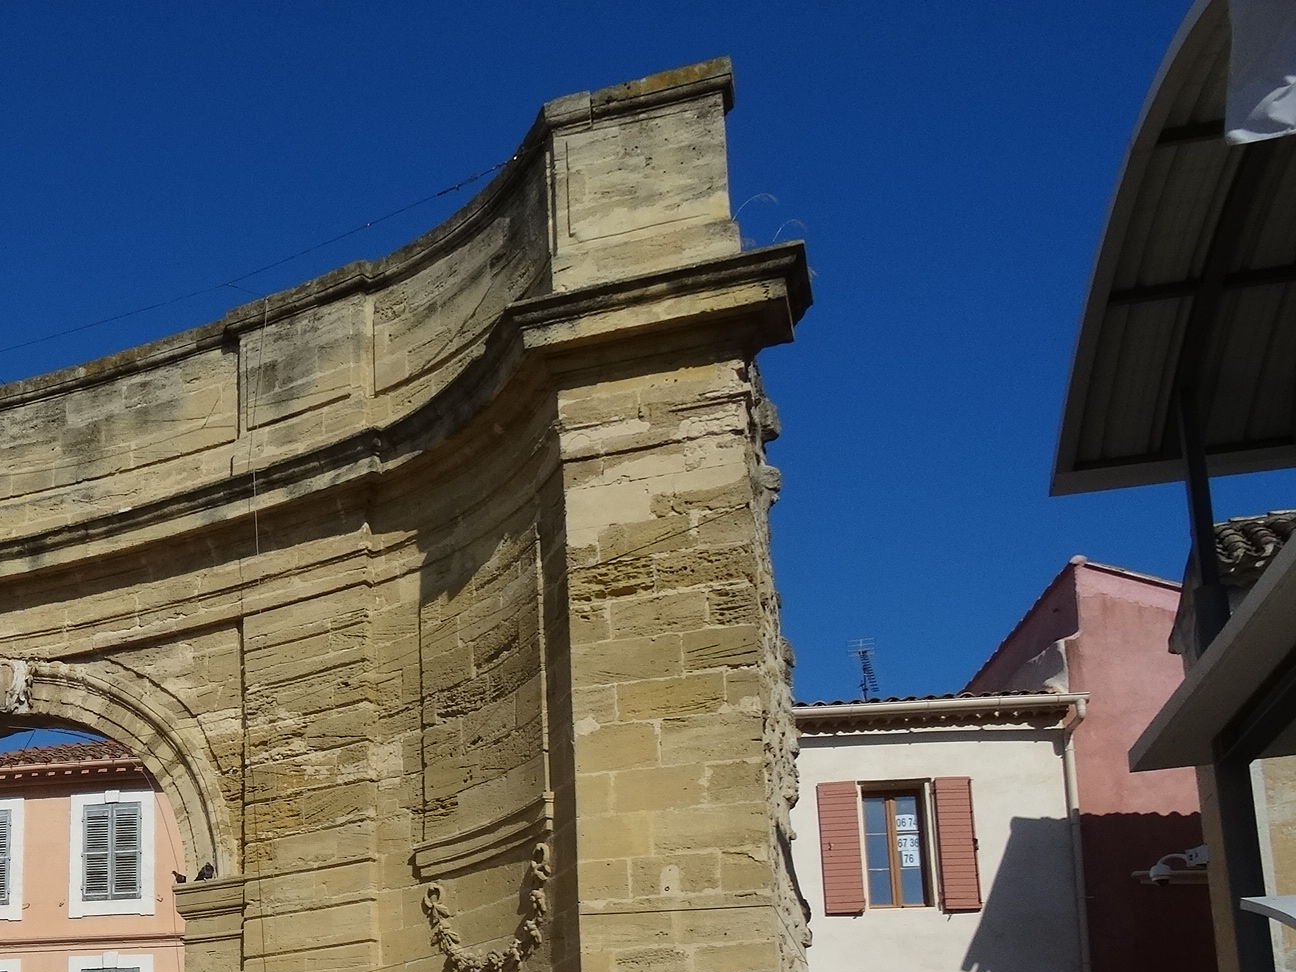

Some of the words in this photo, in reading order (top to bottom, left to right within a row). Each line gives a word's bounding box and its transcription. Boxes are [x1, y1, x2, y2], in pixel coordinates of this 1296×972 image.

[896, 818, 907, 828] 06
[897, 838, 908, 848] 67
[903, 853, 914, 864] 76
